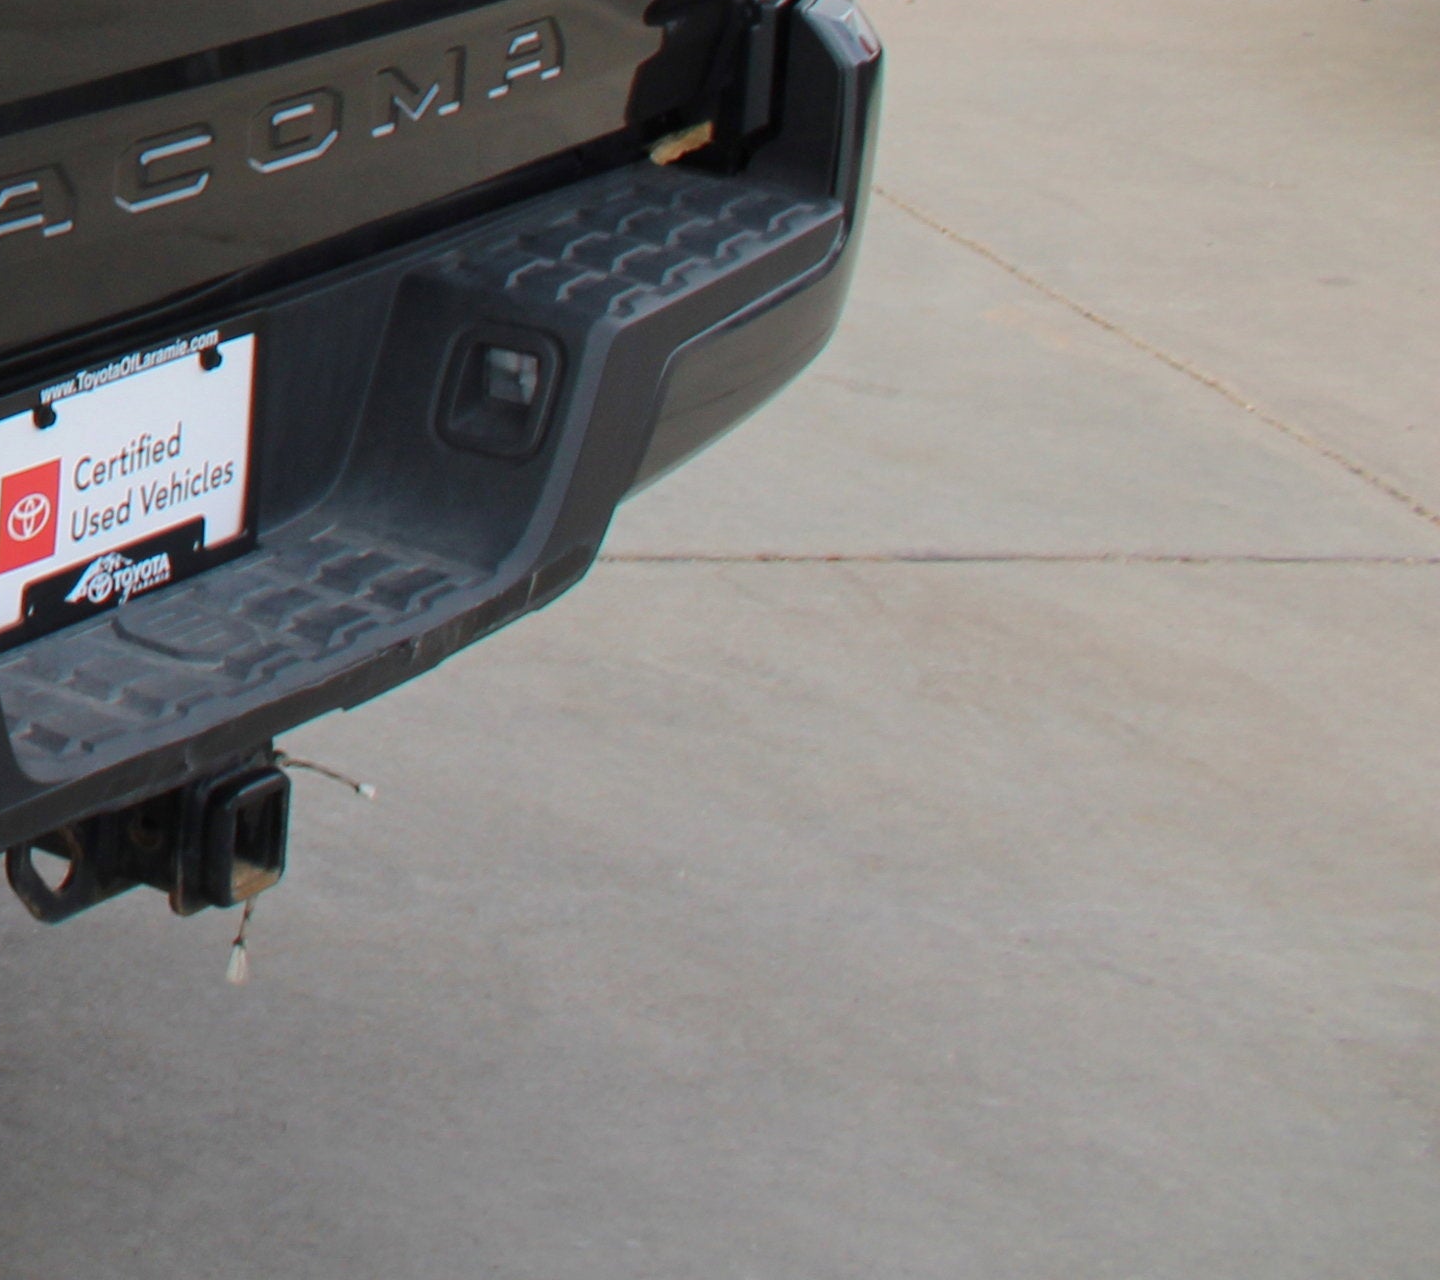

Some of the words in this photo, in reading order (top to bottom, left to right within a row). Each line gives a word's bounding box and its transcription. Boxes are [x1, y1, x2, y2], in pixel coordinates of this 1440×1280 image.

[39, 328, 221, 406] www.ToyotaOfLaramie.com
[72, 420, 183, 493] Certified
[70, 487, 131, 542] Used
[140, 460, 235, 517] Vehicles
[112, 551, 172, 593] TOYOTA
